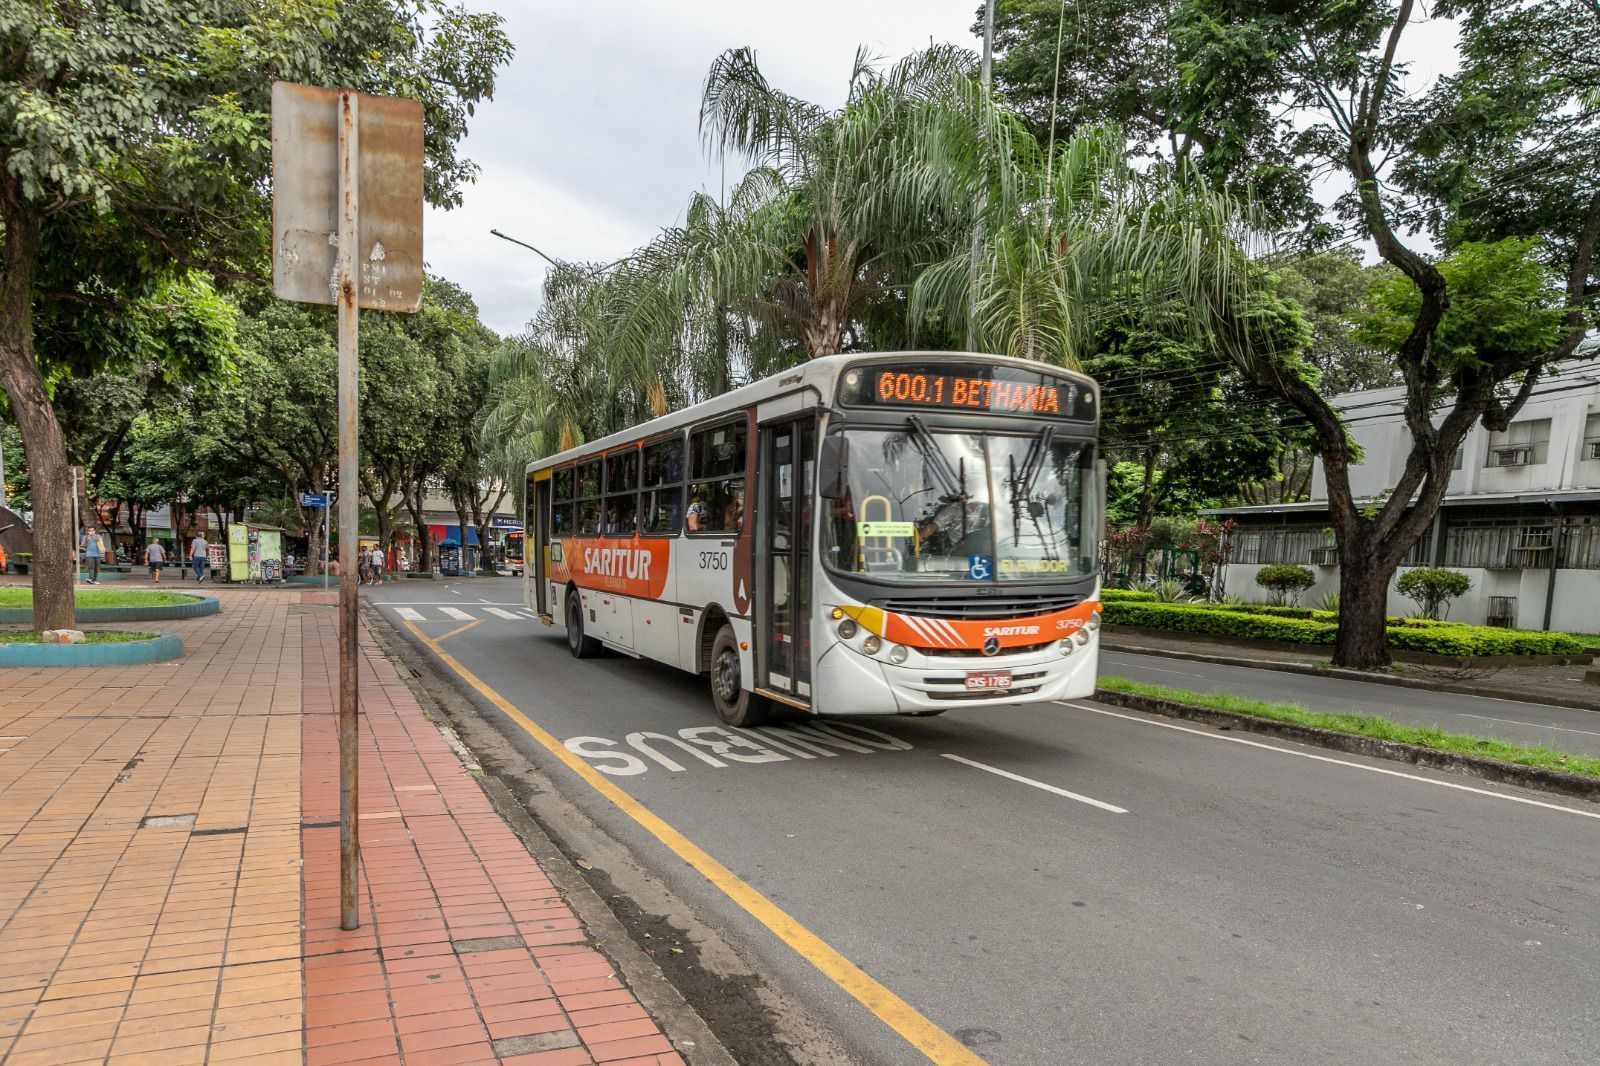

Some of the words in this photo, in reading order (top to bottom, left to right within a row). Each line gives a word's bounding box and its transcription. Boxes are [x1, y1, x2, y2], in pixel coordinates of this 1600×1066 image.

[879, 372, 943, 403] 600.1
[952, 378, 1058, 412] BETHANIA
[584, 547, 652, 580] SARITUR
[699, 551, 728, 570] 3750
[983, 625, 1041, 637] SARITUR
[1056, 618, 1083, 630] 3750
